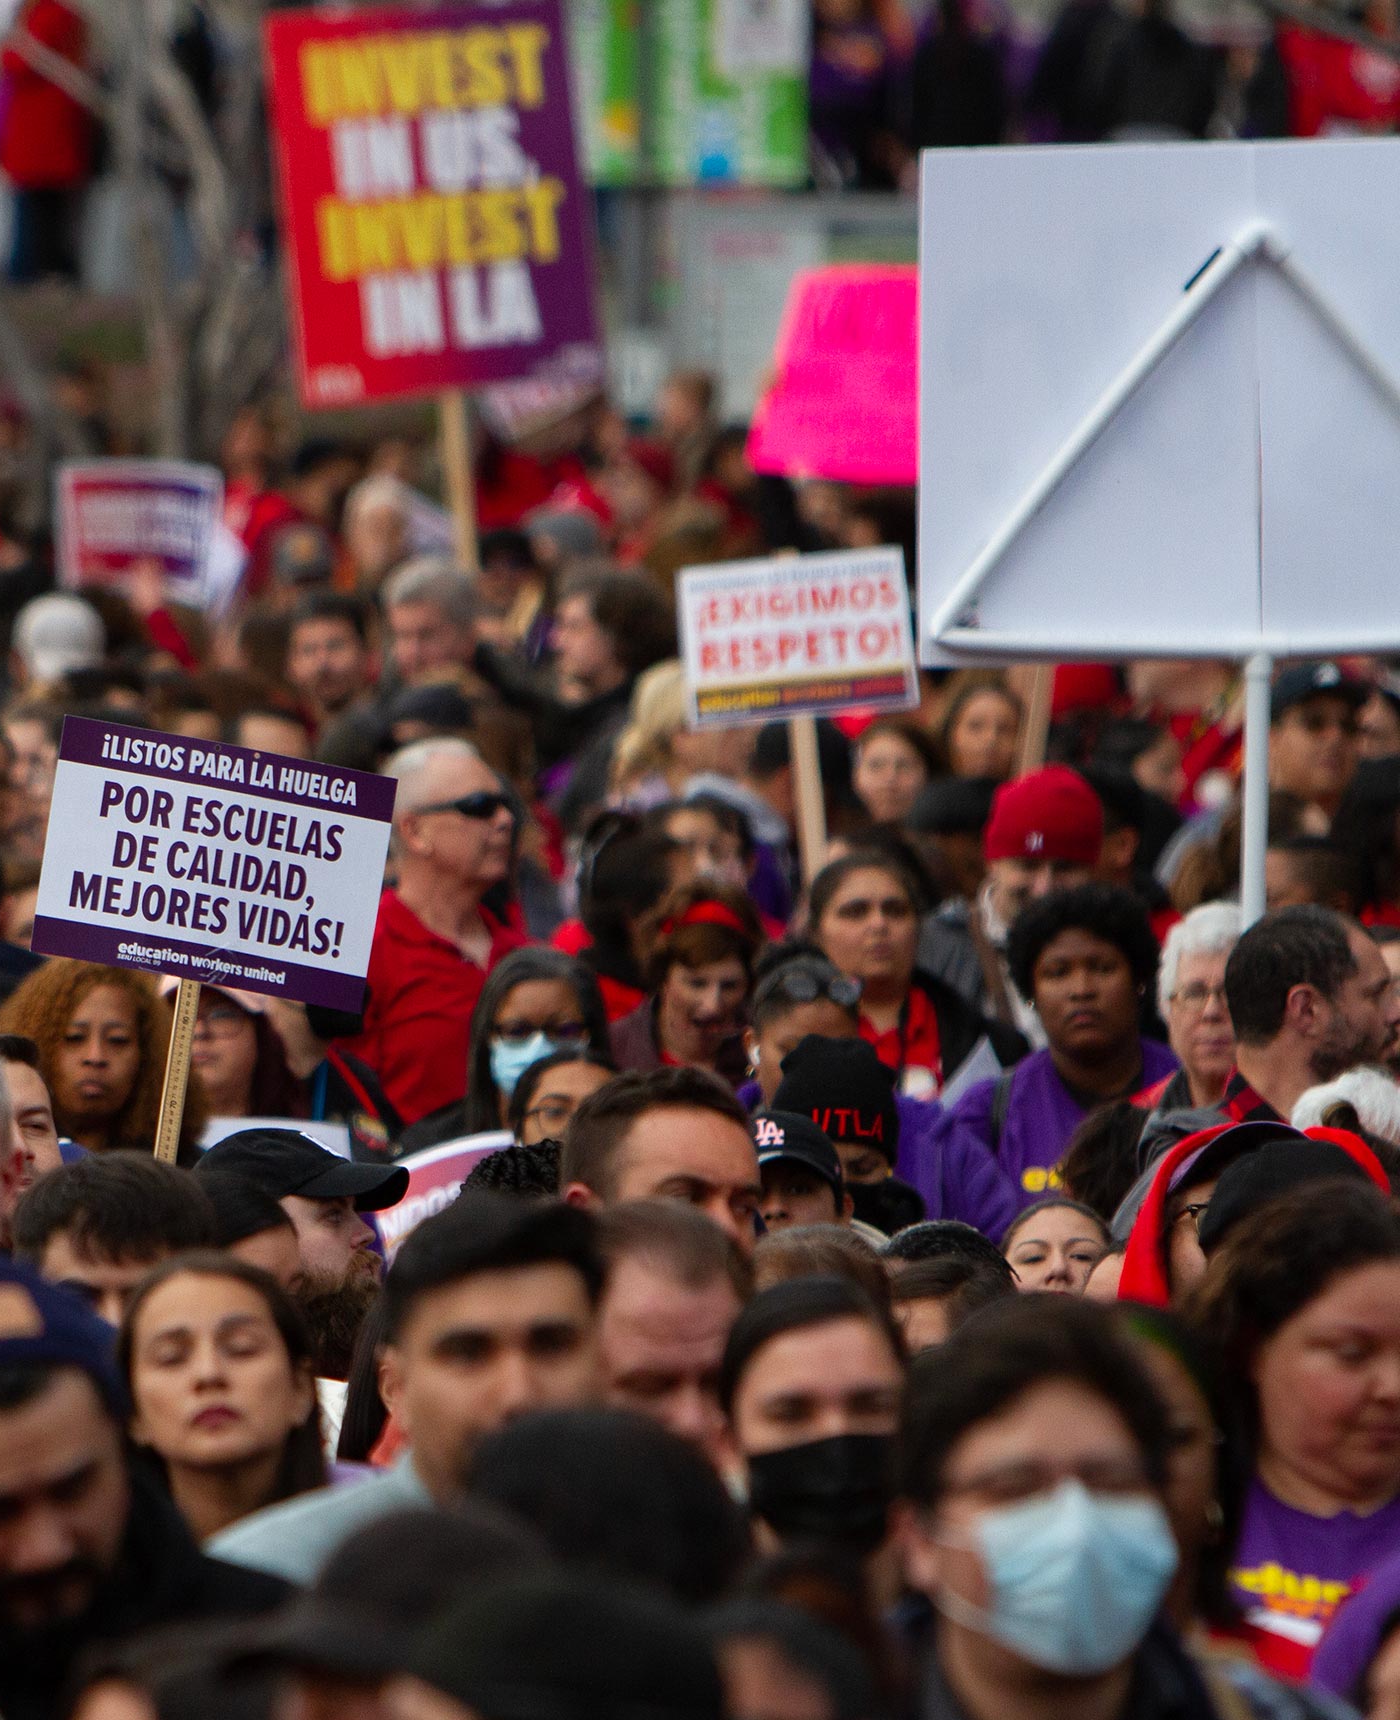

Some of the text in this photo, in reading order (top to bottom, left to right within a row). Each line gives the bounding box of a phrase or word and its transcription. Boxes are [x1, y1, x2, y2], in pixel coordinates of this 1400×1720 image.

[299, 23, 548, 126] INVEST
[331, 106, 539, 201] IN US,
[315, 177, 565, 281] INVEST
[359, 260, 542, 358] IN LA
[700, 621, 902, 674] RESPETO!
[102, 733, 357, 806] ¡LISTOS PARA LA HUELGA
[99, 781, 345, 862] POR ESCUELAS
[112, 831, 316, 911] DE CALIDAD,
[69, 870, 345, 958] MEJORES VIDAS!
[118, 942, 286, 985] education workers united
[133, 956, 152, 965] LOCAL
[754, 1118, 785, 1146] LA
